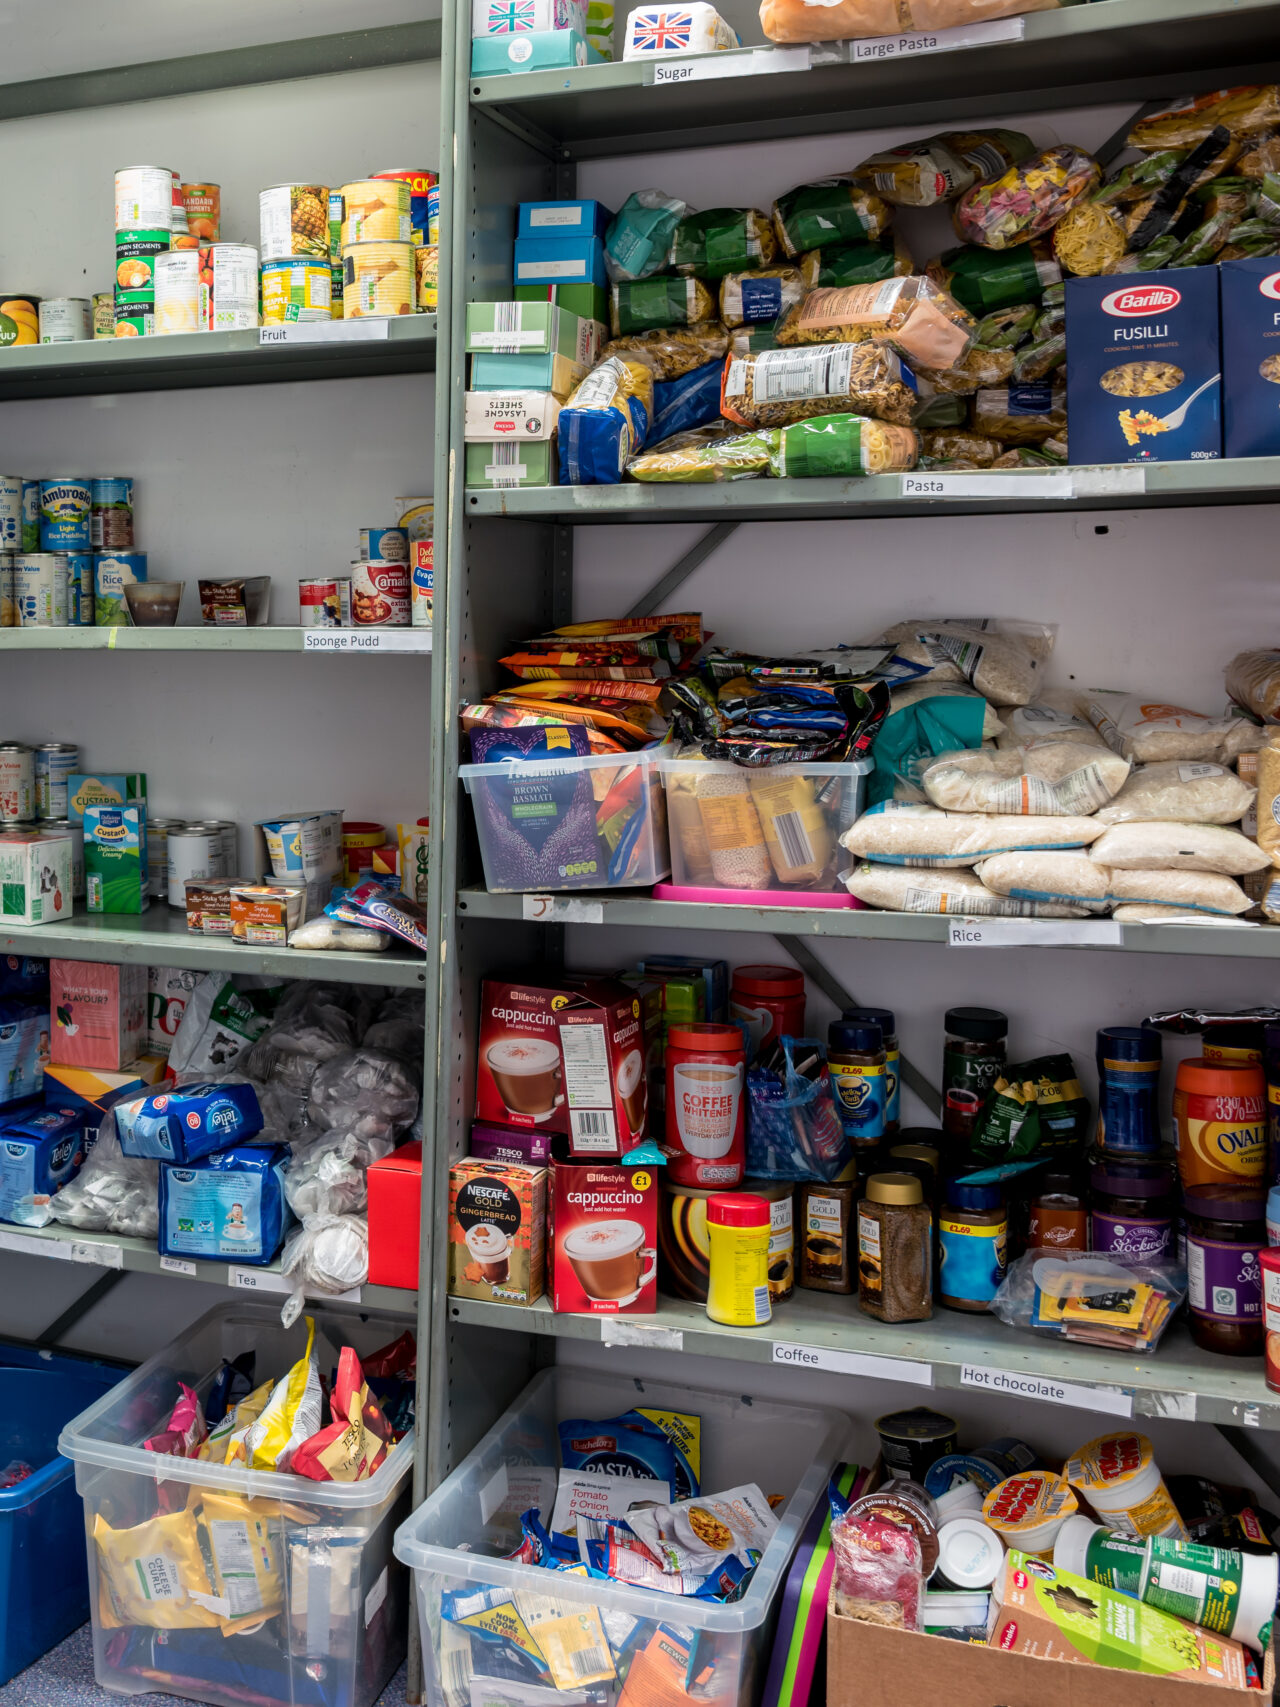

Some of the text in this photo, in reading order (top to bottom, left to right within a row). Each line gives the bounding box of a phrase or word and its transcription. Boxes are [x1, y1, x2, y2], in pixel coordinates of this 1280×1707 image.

[857, 36, 937, 58] Large Pasta
[657, 67, 693, 80] Sugar
[1120, 291, 1173, 309] Barilla
[261, 330, 287, 340] Fruit
[1114, 325, 1168, 341] FUSILLI
[489, 401, 523, 409] SHEETS
[485, 409, 526, 418] LASAGNE
[906, 479, 944, 493] Pasta
[42, 487, 91, 507] Ambrosia
[59, 525, 76, 533] Light
[102, 575, 123, 585] Rice
[306, 635, 379, 647] Sponge Pudd
[514, 785, 549, 794] BROWN
[513, 793, 553, 804] BASMATI
[97, 827, 126, 838] Custard
[952, 930, 982, 942] Rice
[62, 993, 108, 1004] FLAVOUR?
[519, 992, 546, 1004] lifestyle
[491, 1007, 556, 1026] cappuccin
[683, 1092, 733, 1108] COFFEE
[683, 1104, 732, 1118] WHITENER
[496, 1147, 522, 1156] TESCO
[595, 1174, 648, 1186] lifestyle £1
[475, 1196, 502, 1208] GOLD
[567, 1190, 643, 1206] cappuccino
[460, 1207, 517, 1222] GINGERBREAD
[812, 1206, 836, 1215] GOLD
[1110, 1230, 1170, 1254] Stockwell
[237, 1273, 257, 1286] Tea
[775, 1347, 819, 1364] Coffee
[963, 1368, 1065, 1399] Hot chocolate
[663, 1423, 692, 1455] MINUTES
[572, 1489, 608, 1501] Tomato
[579, 1500, 609, 1511] Onion
[148, 1561, 164, 1595] CURLS
[154, 1557, 172, 1597] CHEESE
[496, 1612, 518, 1624] NOW
[490, 1617, 519, 1634] COOKS
[499, 1628, 527, 1648] FASTER
[1001, 1623, 1017, 1650] Yutaka
